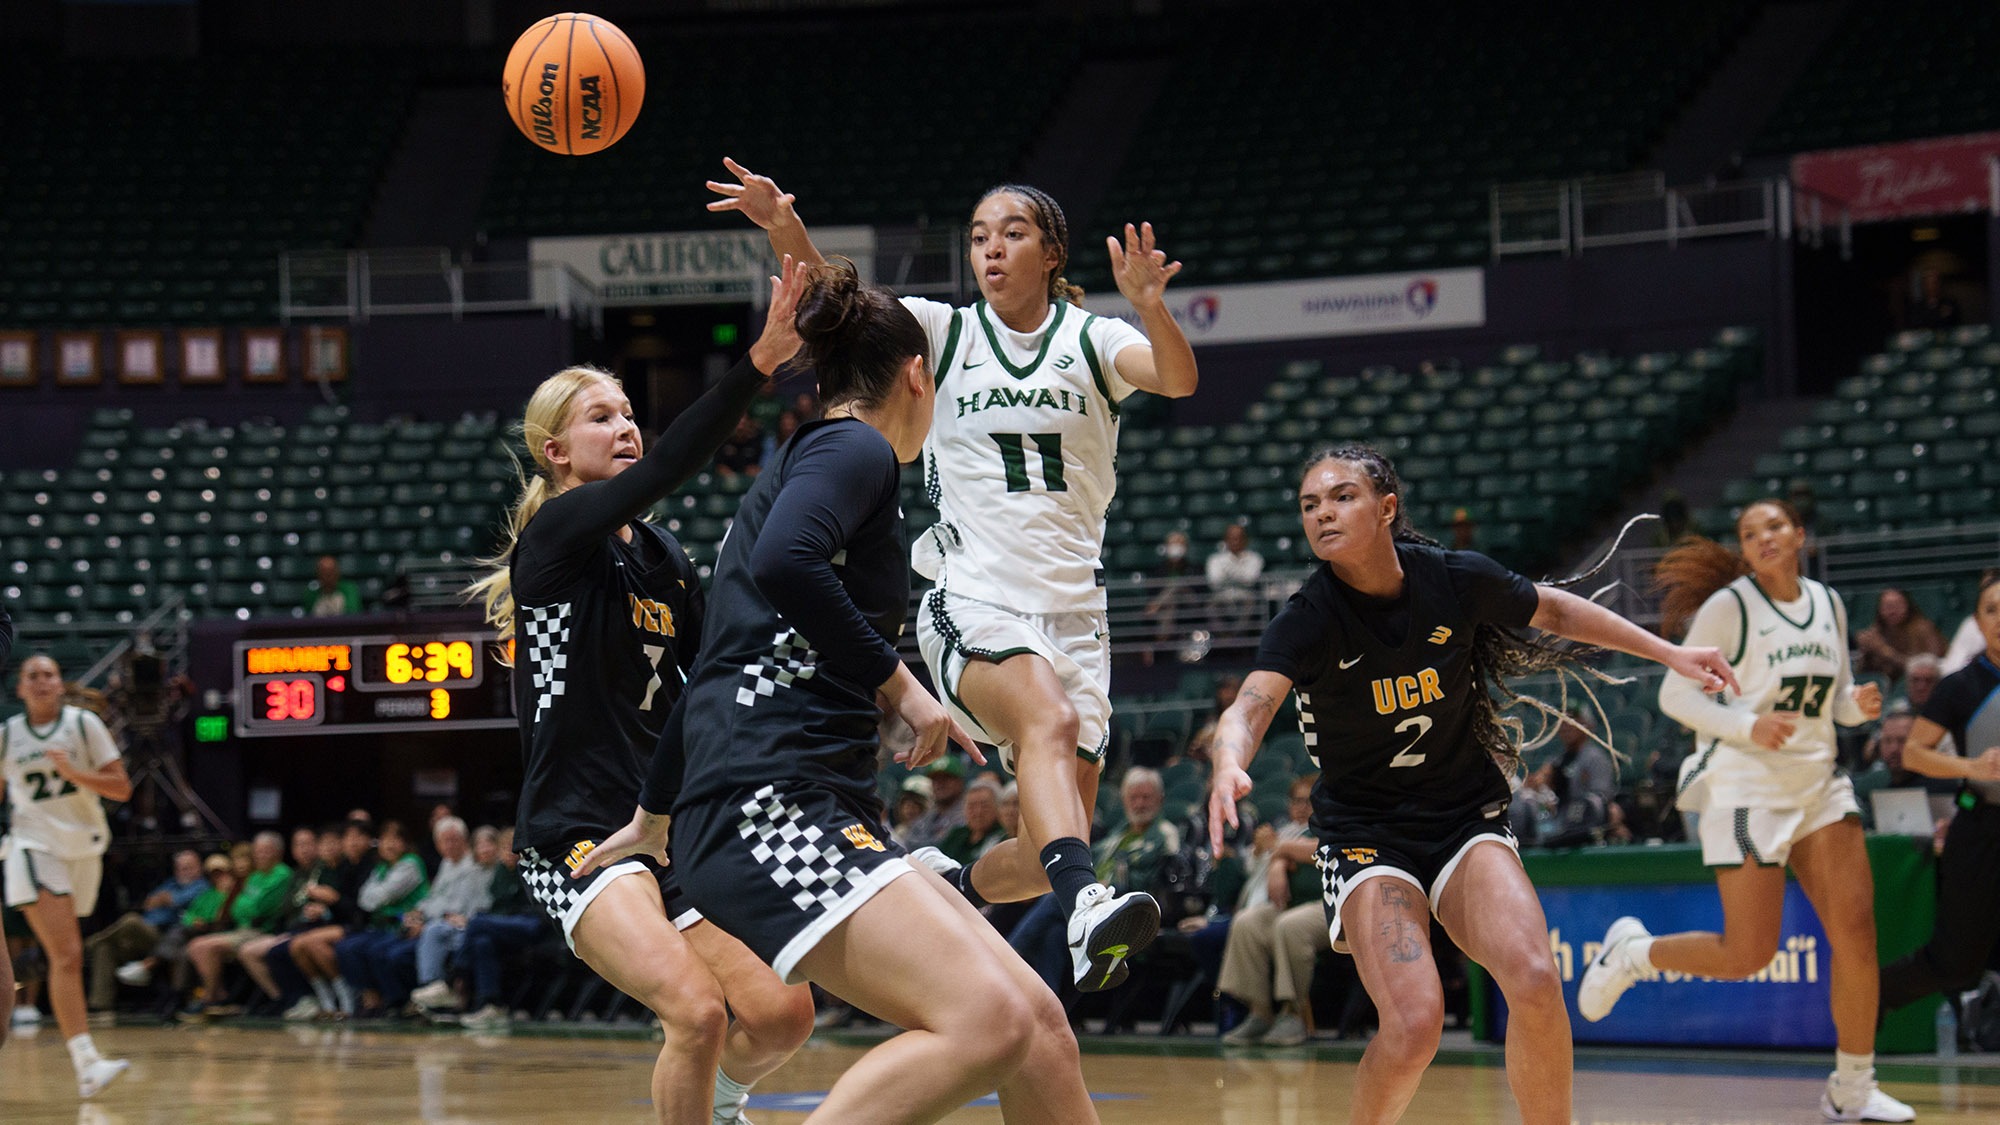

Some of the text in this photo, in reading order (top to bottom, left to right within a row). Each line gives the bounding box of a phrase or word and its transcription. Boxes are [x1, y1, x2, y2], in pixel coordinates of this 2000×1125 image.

[531, 63, 559, 146] Wilson
[580, 75, 602, 140] NCAA
[601, 236, 782, 277] CALIFORN
[956, 387, 1088, 419] HAWAI'I
[987, 432, 1068, 492] 11
[628, 592, 676, 637] UCR
[385, 641, 473, 684] 6:39
[266, 679, 315, 721] 30
[430, 688, 450, 719] 3
[1371, 667, 1446, 715] UCR
[1773, 675, 1834, 717] 33
[1389, 714, 1433, 768] 2
